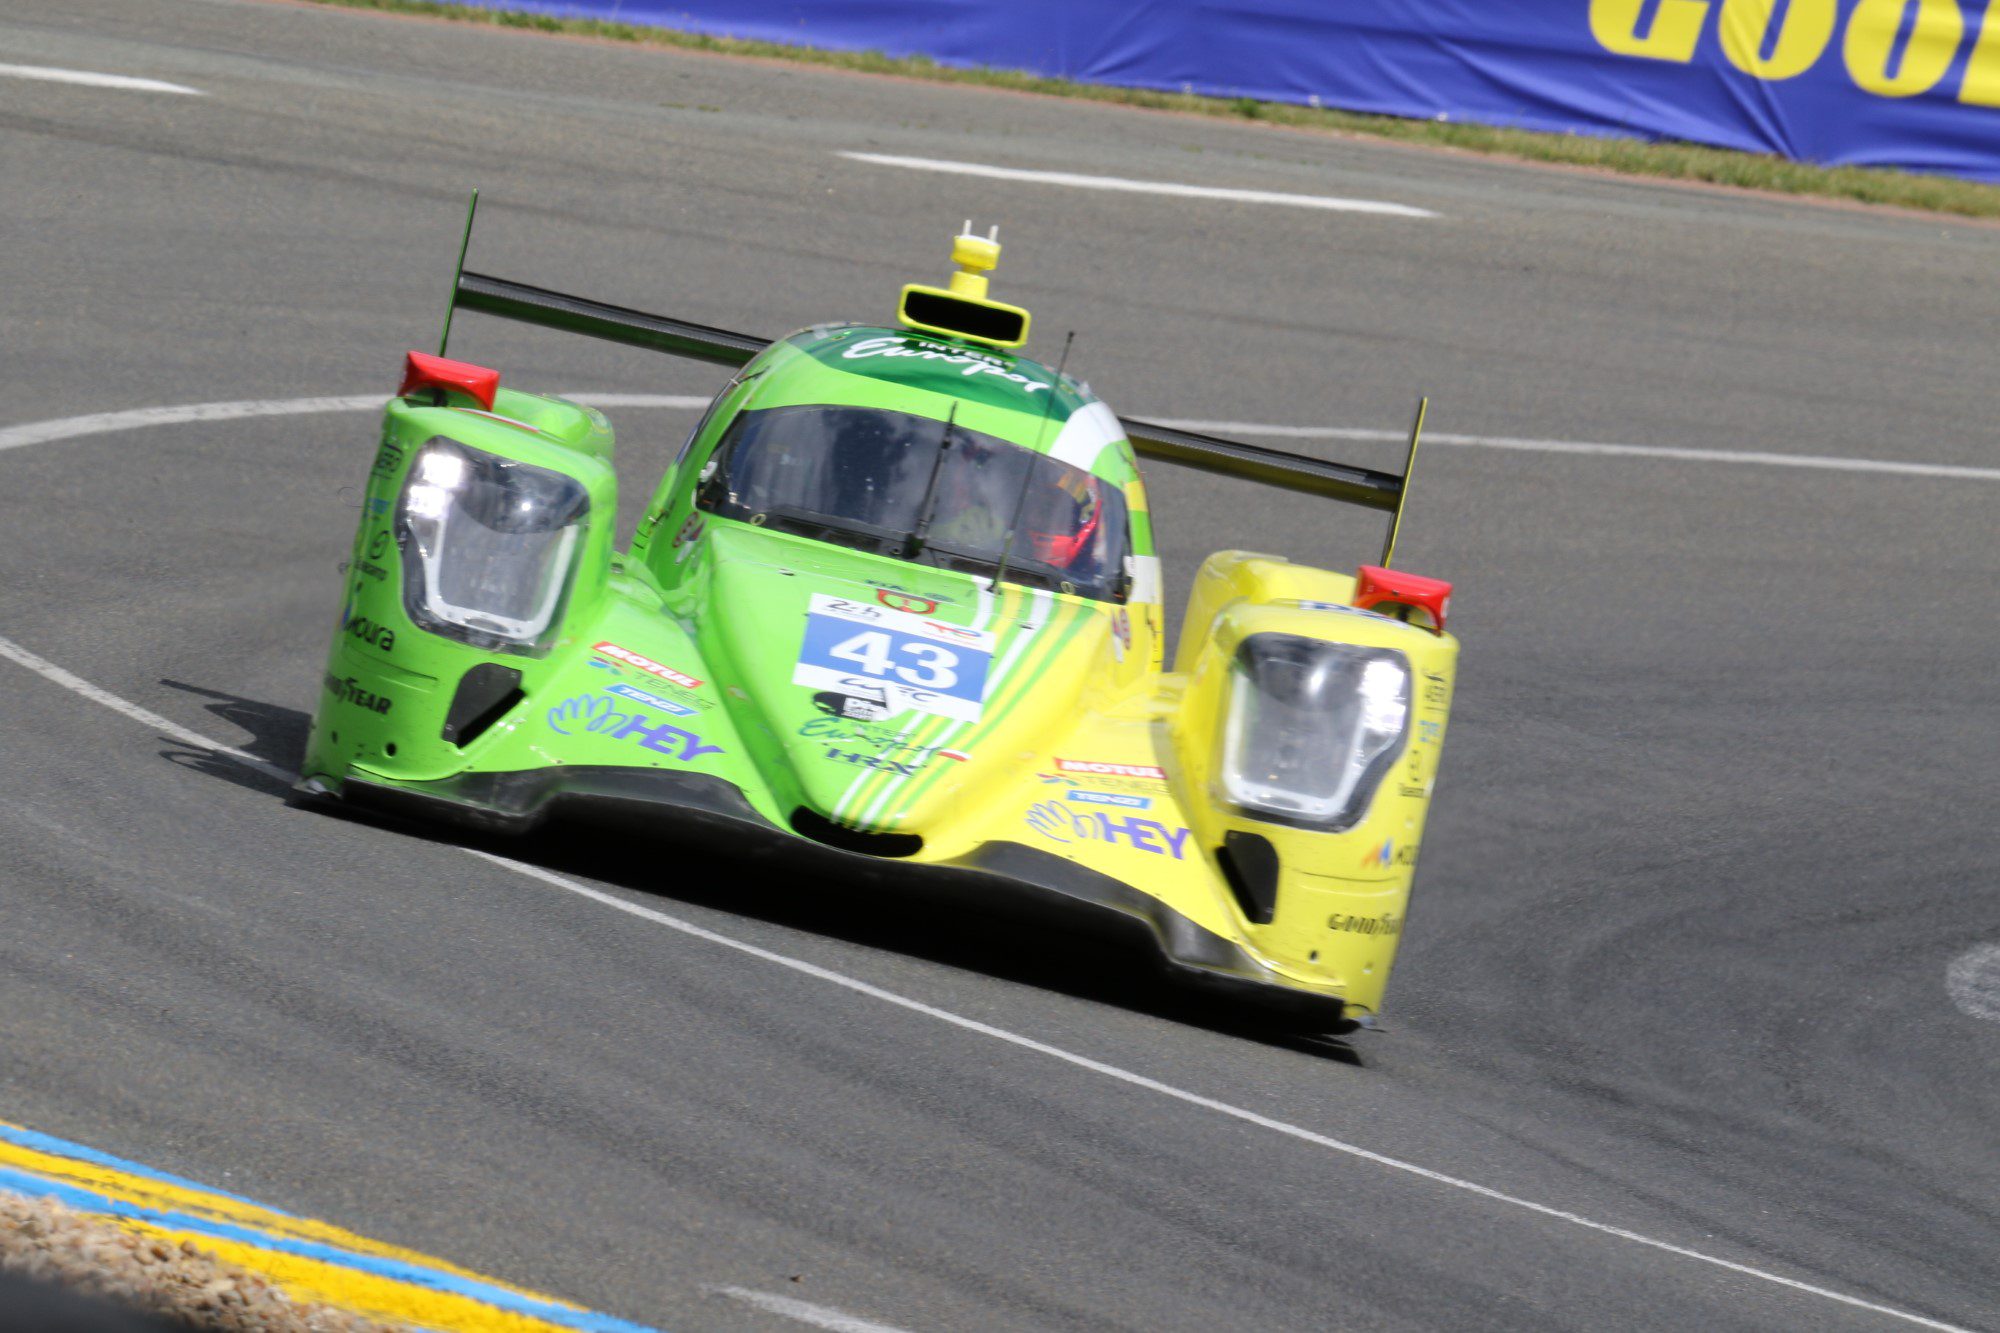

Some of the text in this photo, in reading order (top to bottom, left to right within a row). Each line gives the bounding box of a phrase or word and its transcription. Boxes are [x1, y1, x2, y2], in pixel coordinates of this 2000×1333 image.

[599, 644, 698, 688] MOTUL
[830, 631, 960, 690] 43
[612, 714, 726, 762] HEY
[1060, 760, 1165, 779] MOTUL
[1095, 812, 1191, 860] HEY
